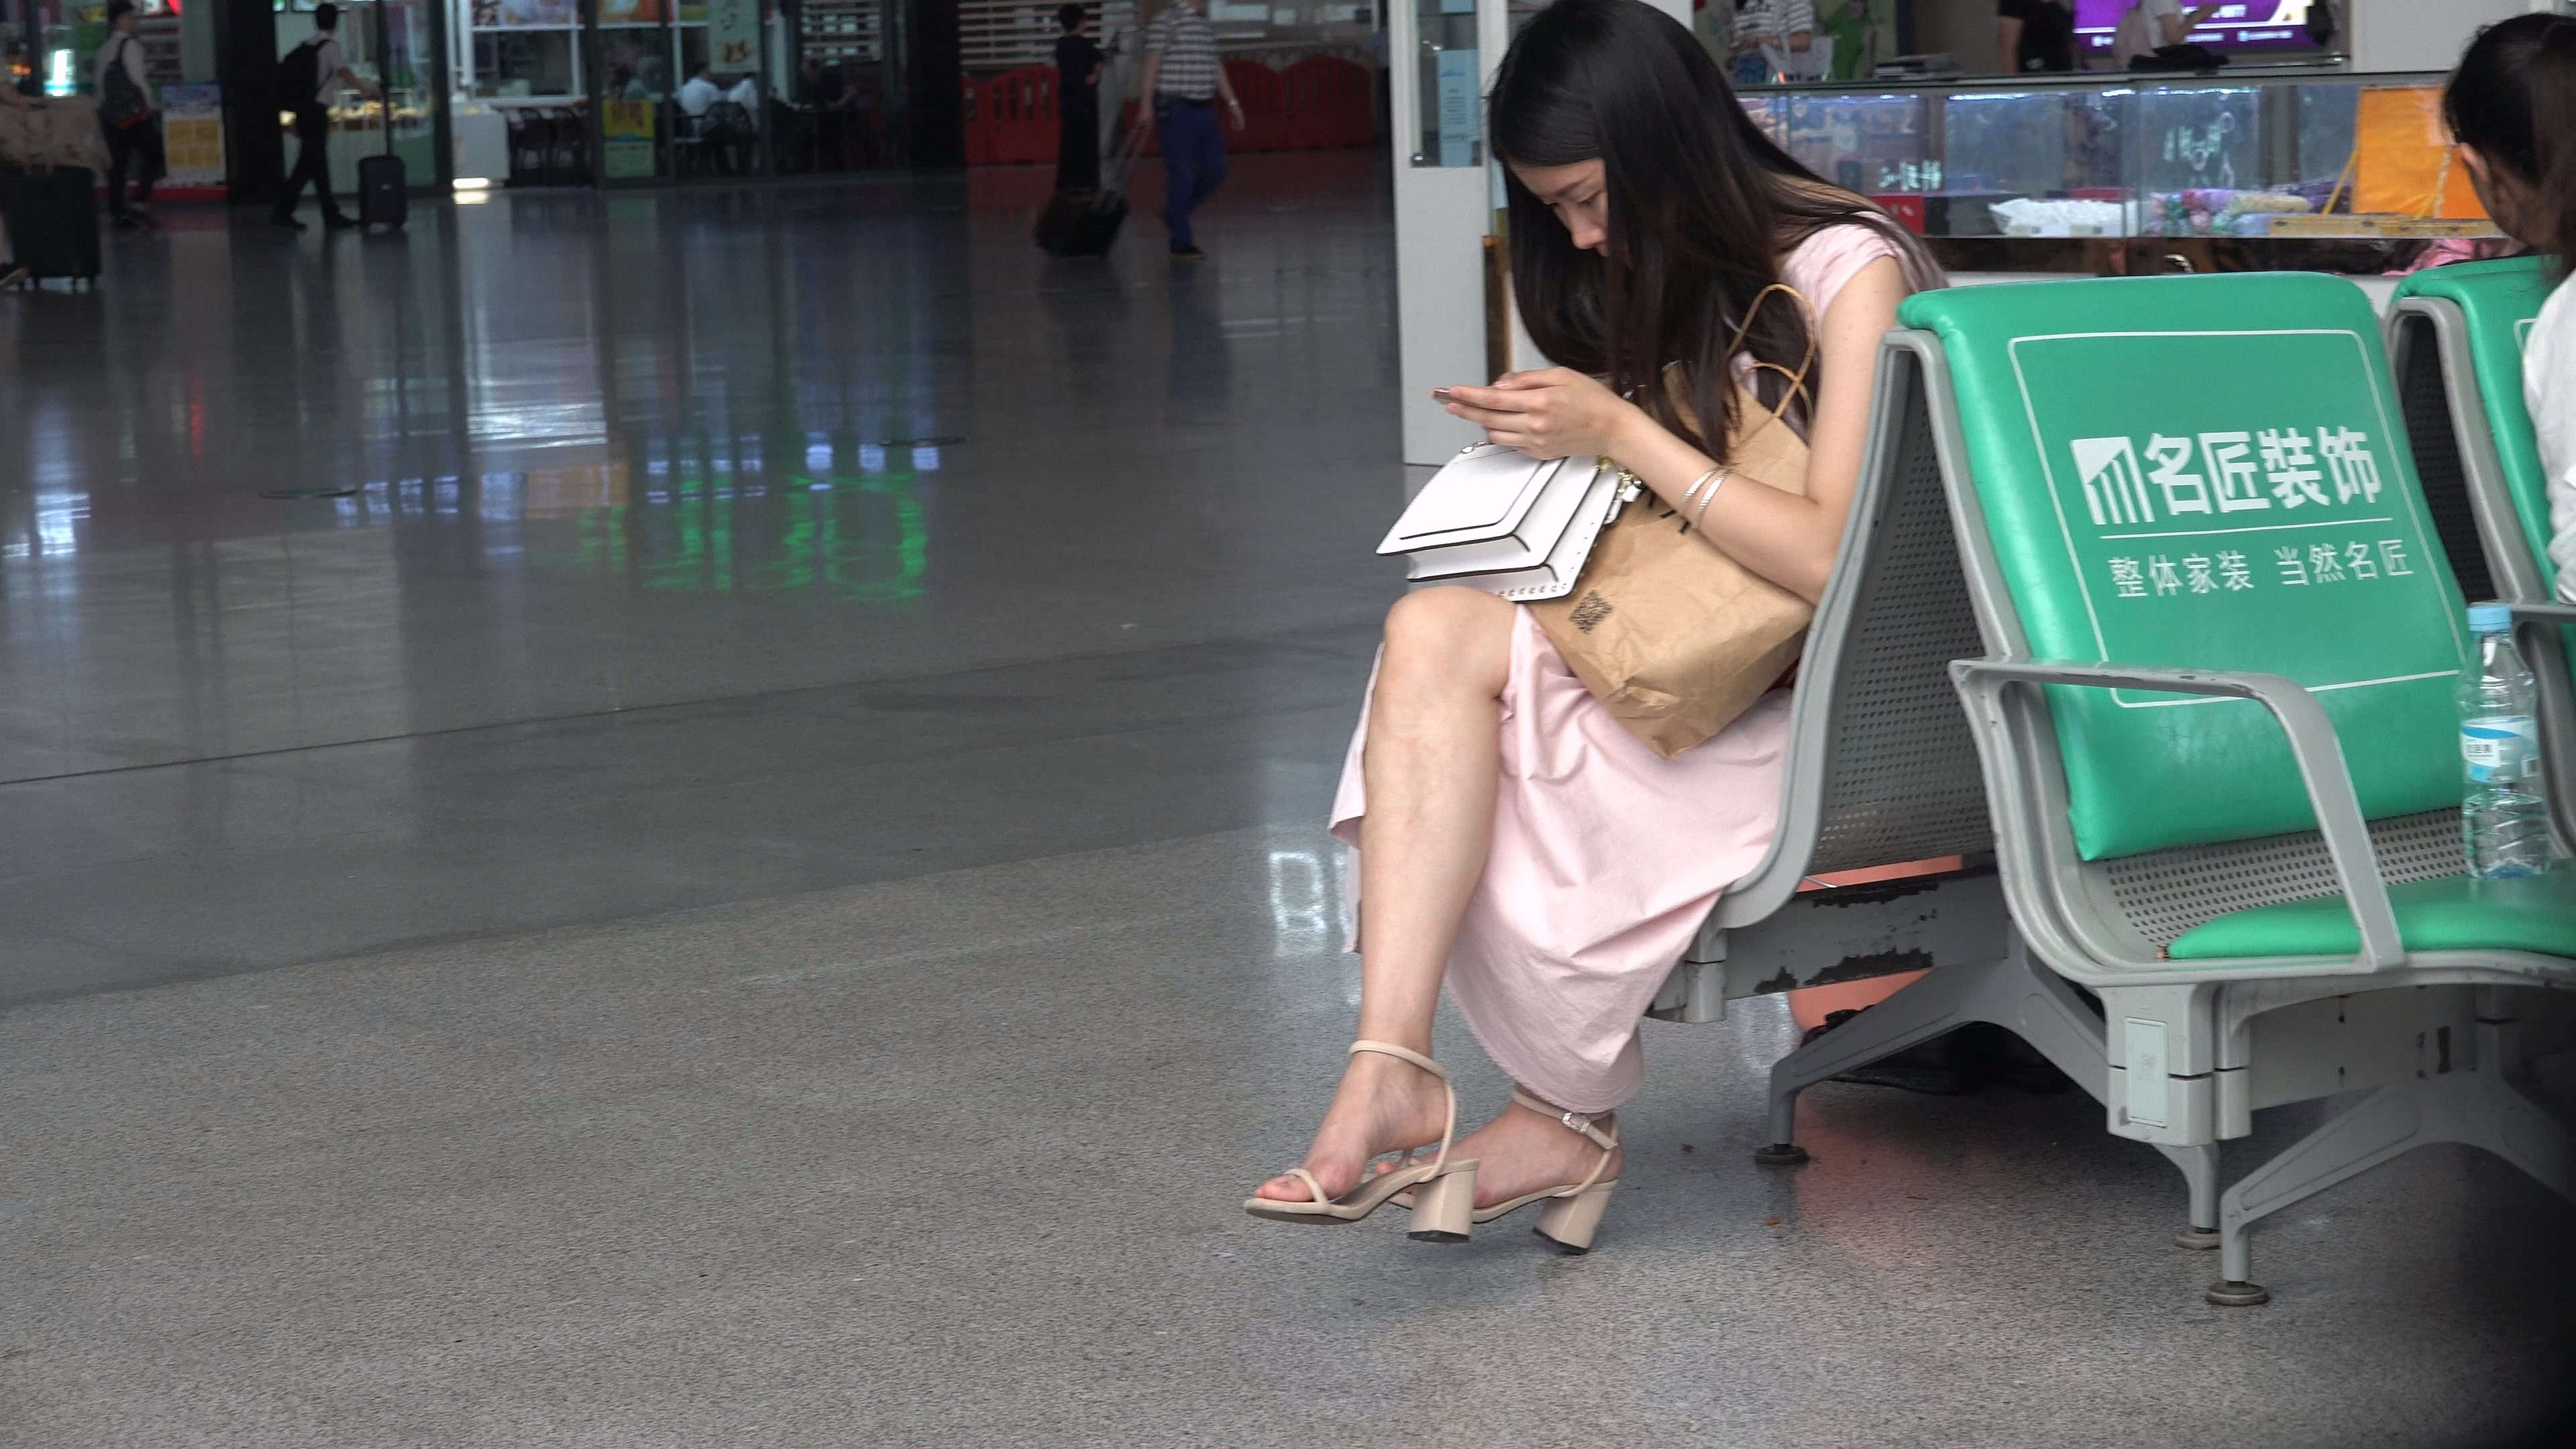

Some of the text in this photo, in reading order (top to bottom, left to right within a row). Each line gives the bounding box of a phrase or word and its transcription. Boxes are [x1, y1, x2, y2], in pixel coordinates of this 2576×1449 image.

[2146, 426, 2381, 516] 名匠装饰
[2108, 539, 2414, 597] 整体家装 当然名匠
